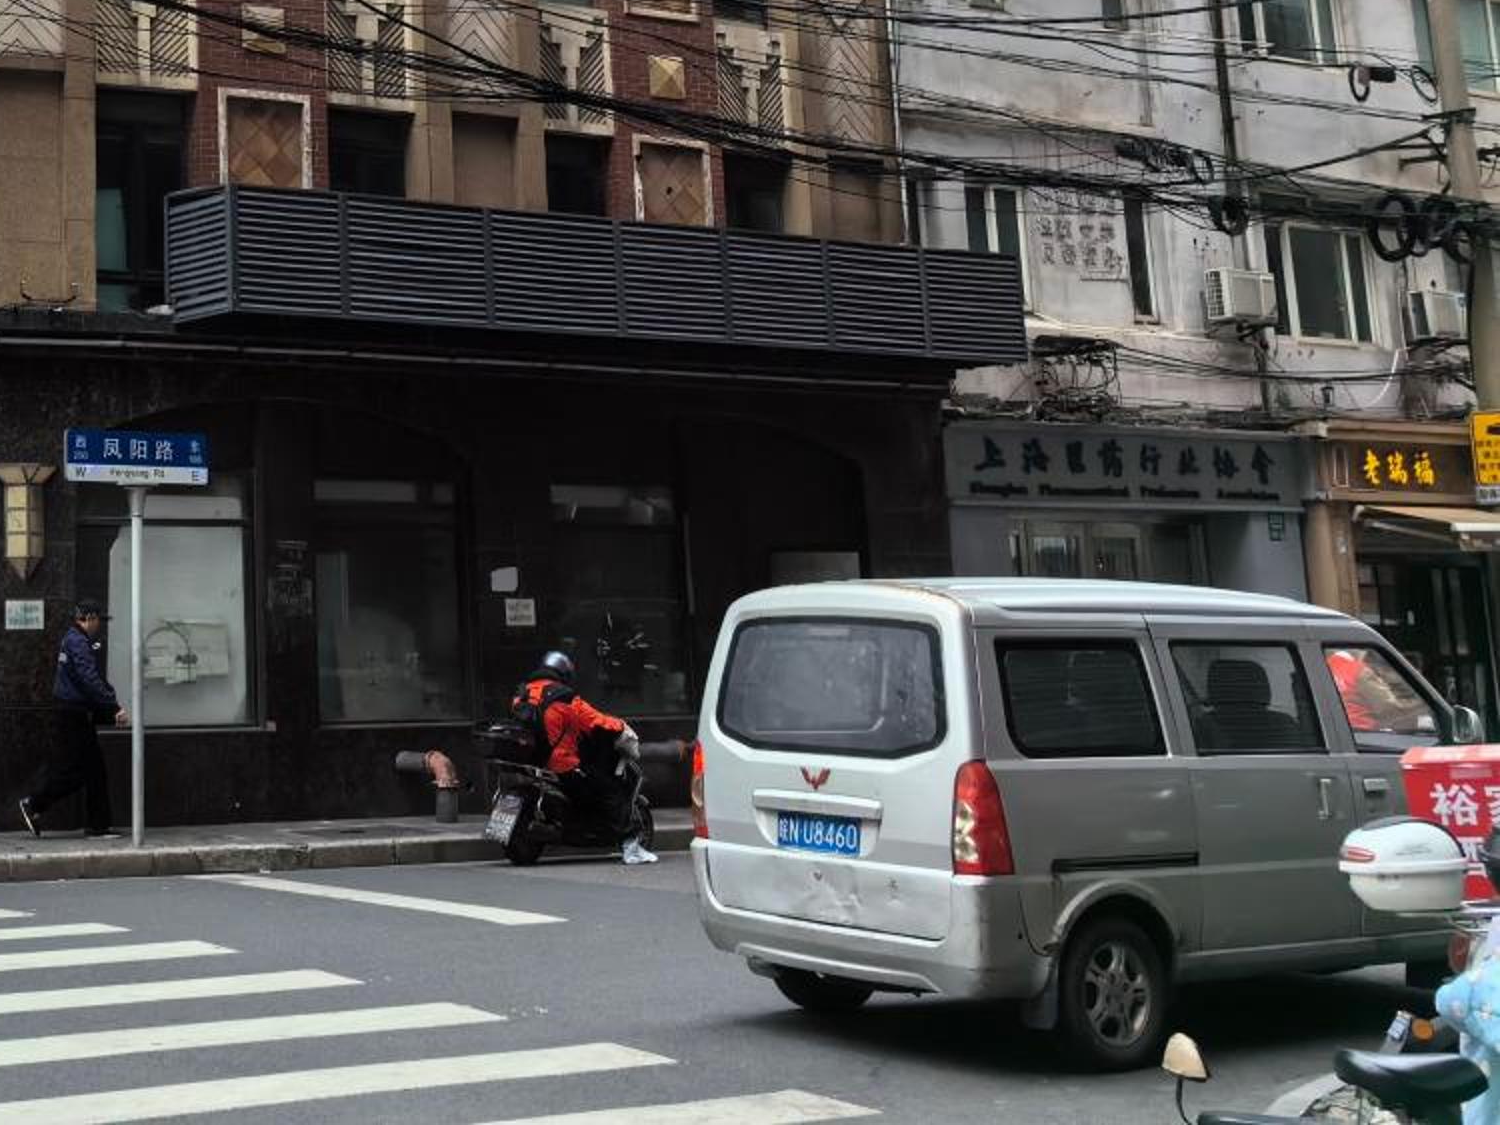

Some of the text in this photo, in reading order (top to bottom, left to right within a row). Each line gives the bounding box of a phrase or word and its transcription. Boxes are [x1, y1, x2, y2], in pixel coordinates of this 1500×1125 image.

[103, 438, 174, 462] 凤阳路
[75, 467, 87, 478] W
[191, 471, 200, 482] E
